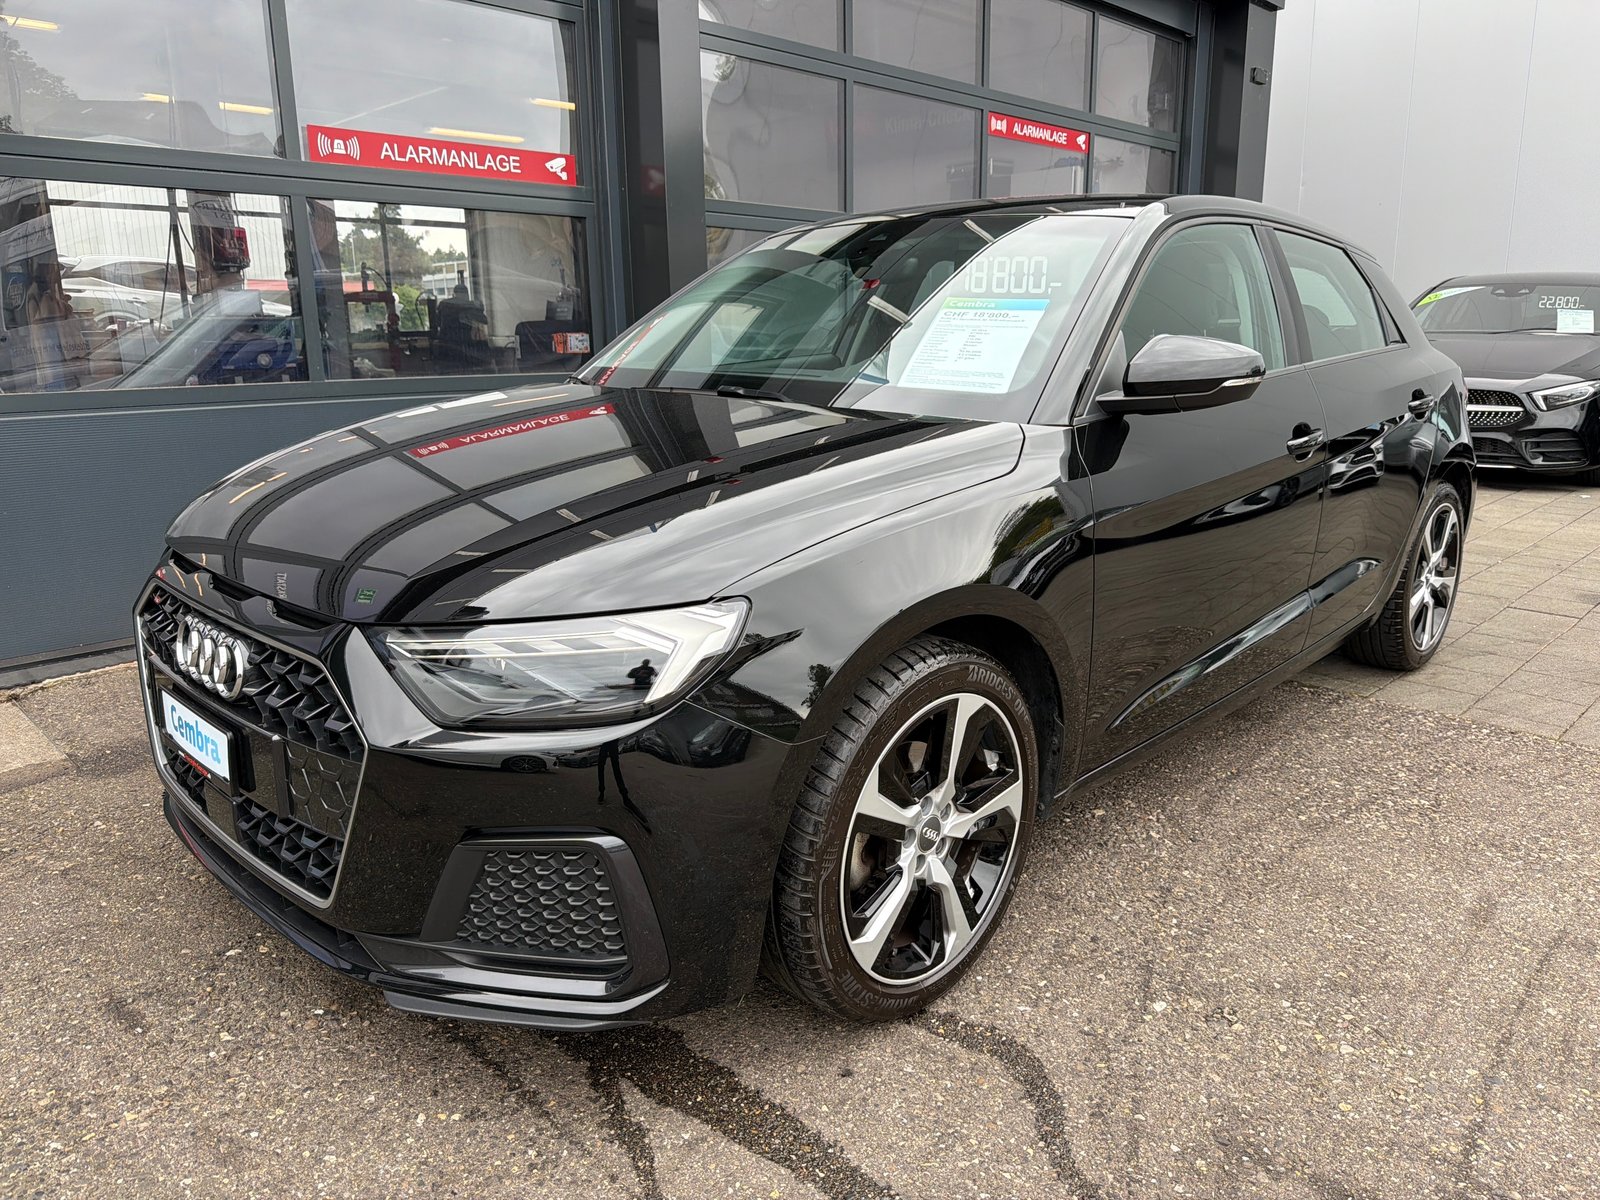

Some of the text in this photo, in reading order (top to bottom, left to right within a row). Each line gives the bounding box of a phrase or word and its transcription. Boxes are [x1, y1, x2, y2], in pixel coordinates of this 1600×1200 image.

[1013, 122, 1068, 145] ALARMANLAGE
[380, 142, 522, 174] ALARMANLAGE
[949, 300, 996, 309] Cembra
[170, 704, 221, 765] Cembra
